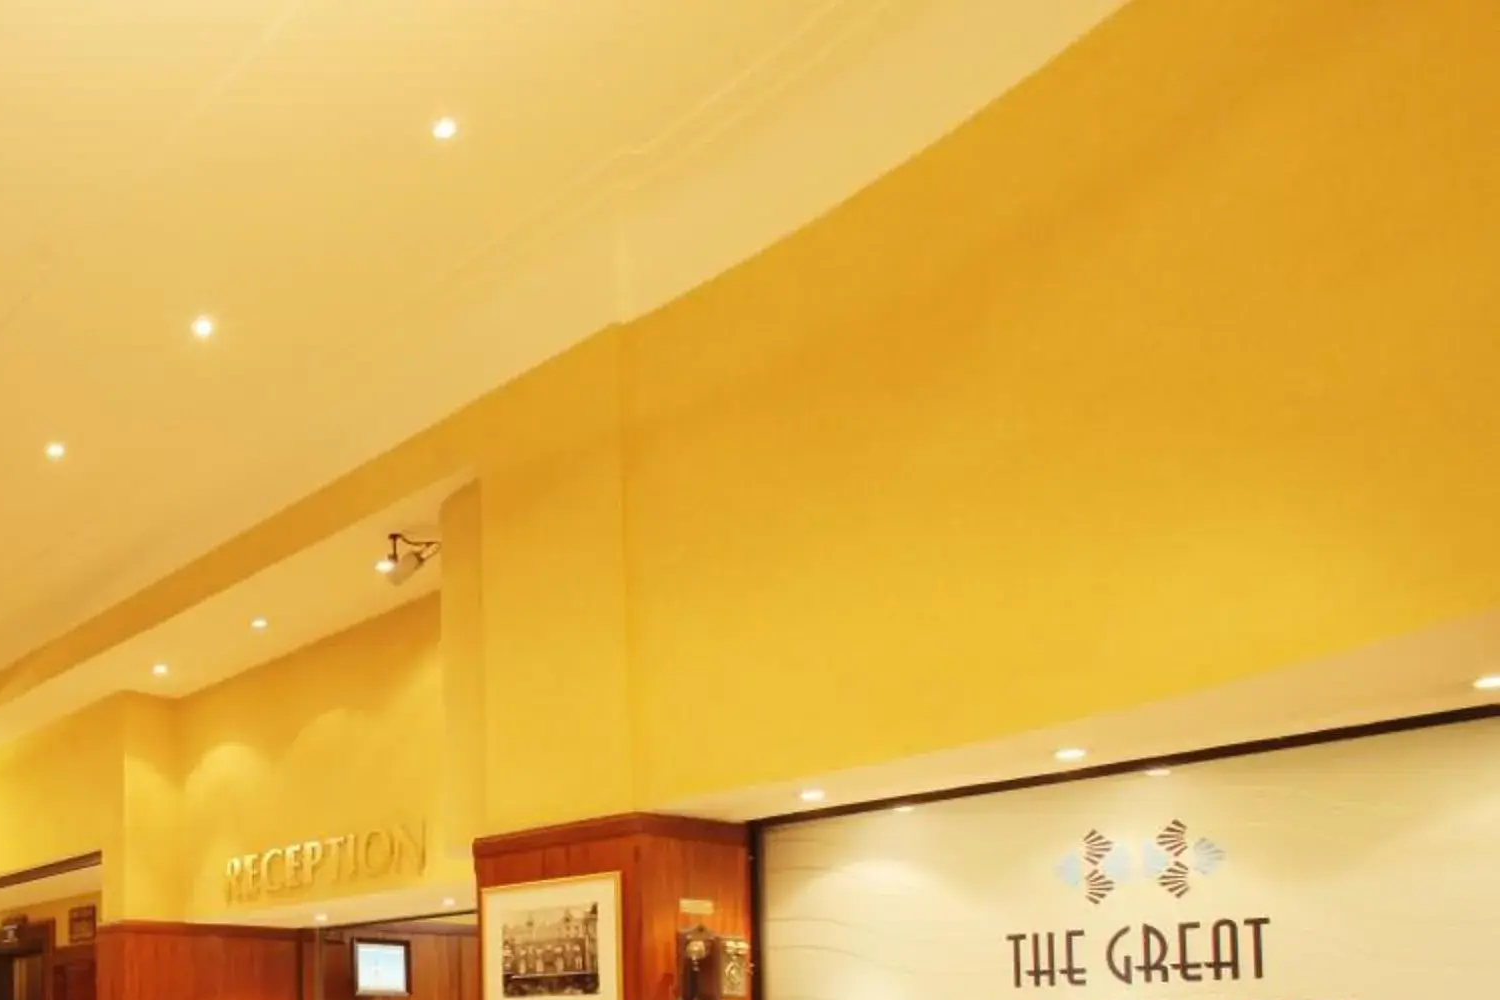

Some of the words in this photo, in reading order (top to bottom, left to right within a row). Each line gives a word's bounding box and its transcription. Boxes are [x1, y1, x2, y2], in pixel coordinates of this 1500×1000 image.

[225, 817, 426, 906] RECEPTION
[1006, 929, 1086, 988] THE
[1106, 917, 1271, 985] GREAT
